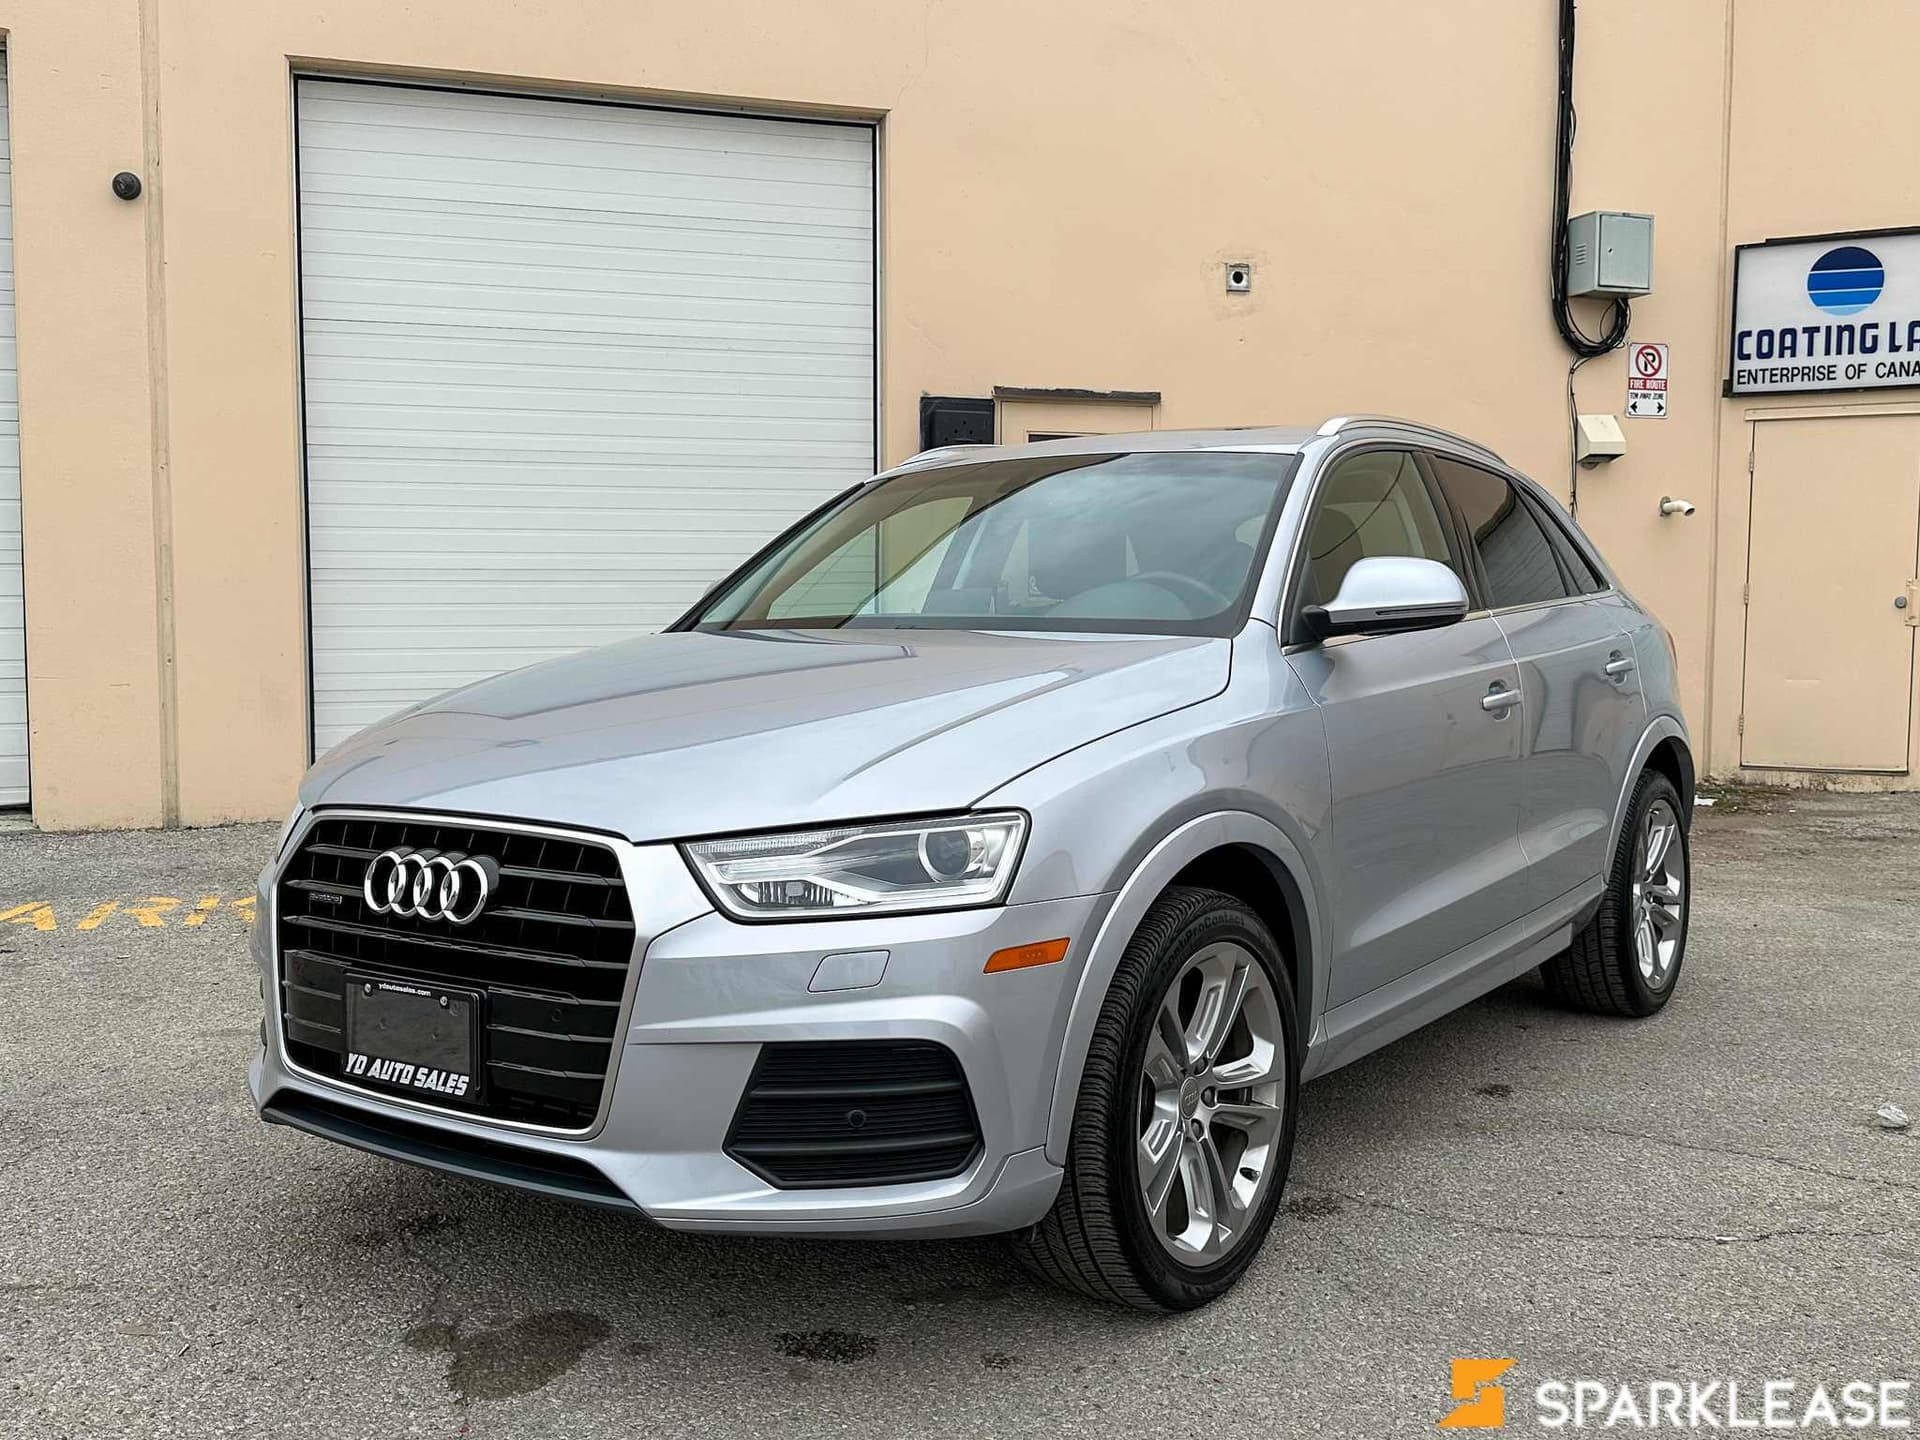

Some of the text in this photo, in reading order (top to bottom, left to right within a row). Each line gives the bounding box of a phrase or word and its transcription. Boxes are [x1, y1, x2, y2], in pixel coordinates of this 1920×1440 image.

[1737, 323, 1879, 360] COATING
[1630, 379, 1666, 390] FIRE ROUTE
[1737, 360, 1920, 385] ENTERPRISE OF CANA
[367, 1058, 415, 1084] AUTO
[413, 1067, 470, 1096] SALES
